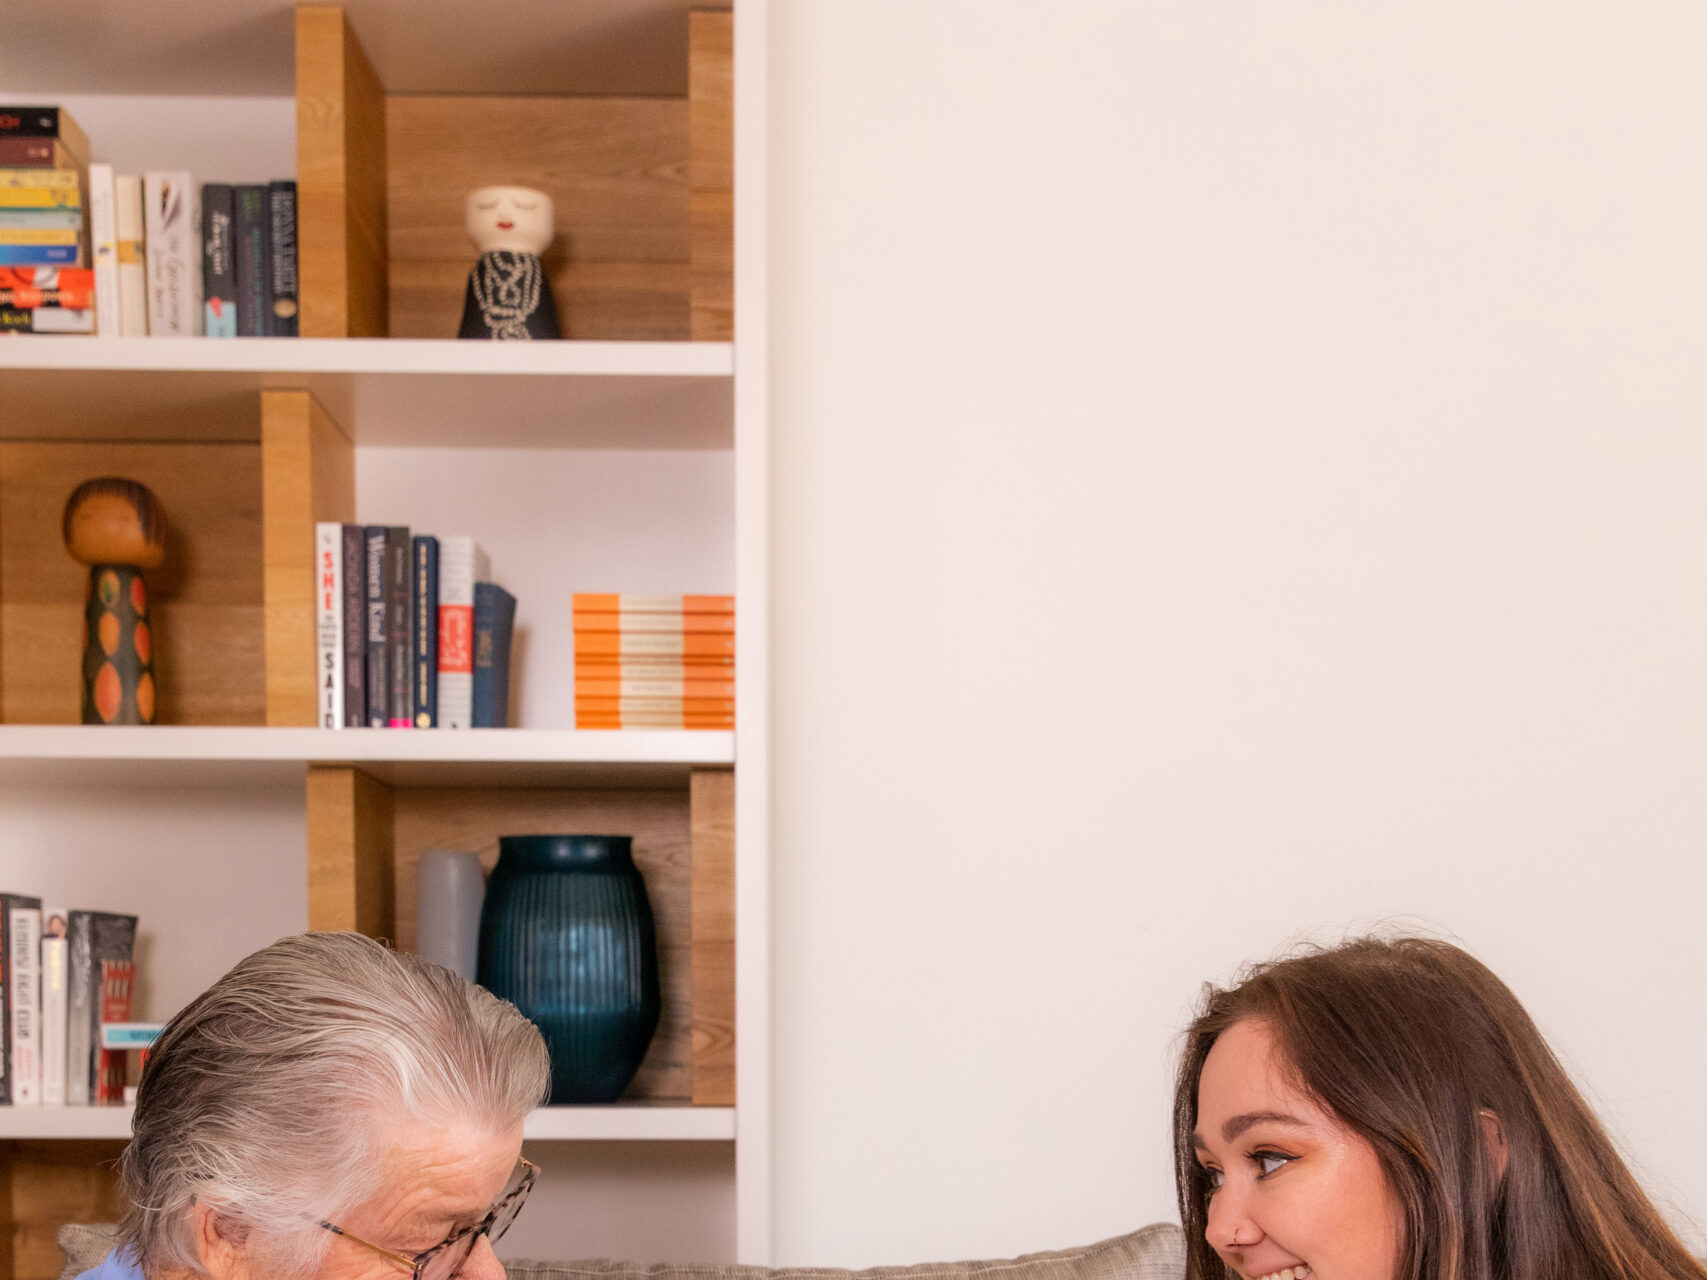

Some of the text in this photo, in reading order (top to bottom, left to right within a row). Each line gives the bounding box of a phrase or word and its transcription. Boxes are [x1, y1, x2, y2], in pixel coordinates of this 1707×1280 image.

[323, 552, 334, 611] SHE
[368, 535, 385, 598] Women
[369, 601, 386, 642] Kind
